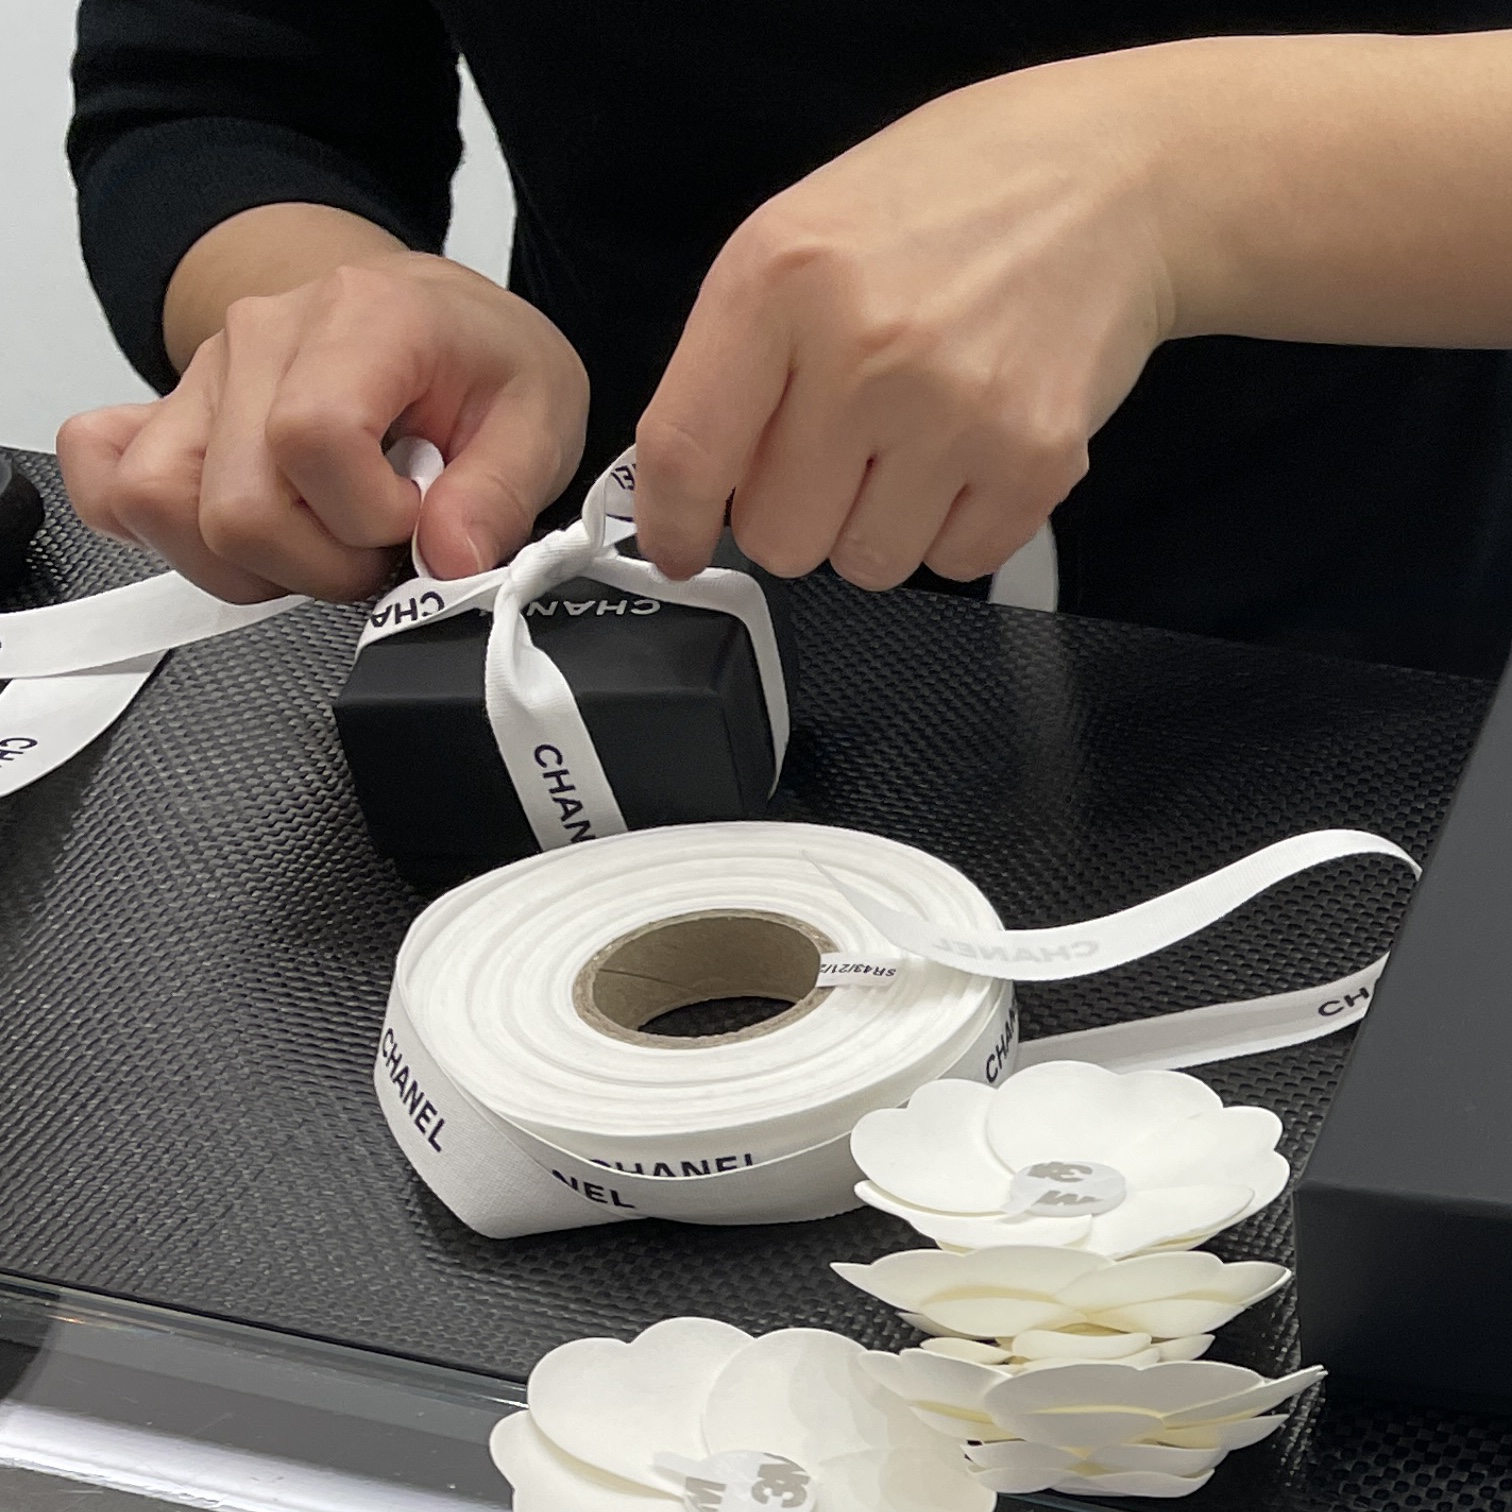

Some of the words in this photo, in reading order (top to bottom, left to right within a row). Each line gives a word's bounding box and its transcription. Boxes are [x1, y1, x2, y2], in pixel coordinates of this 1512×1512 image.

[370, 591, 445, 628] CHA
[527, 599, 661, 616] CHAN
[534, 744, 596, 844] CHAN
[986, 998, 1018, 1083] CHAN
[381, 1028, 446, 1152] CHANEL
[552, 1169, 636, 1209] NEL
